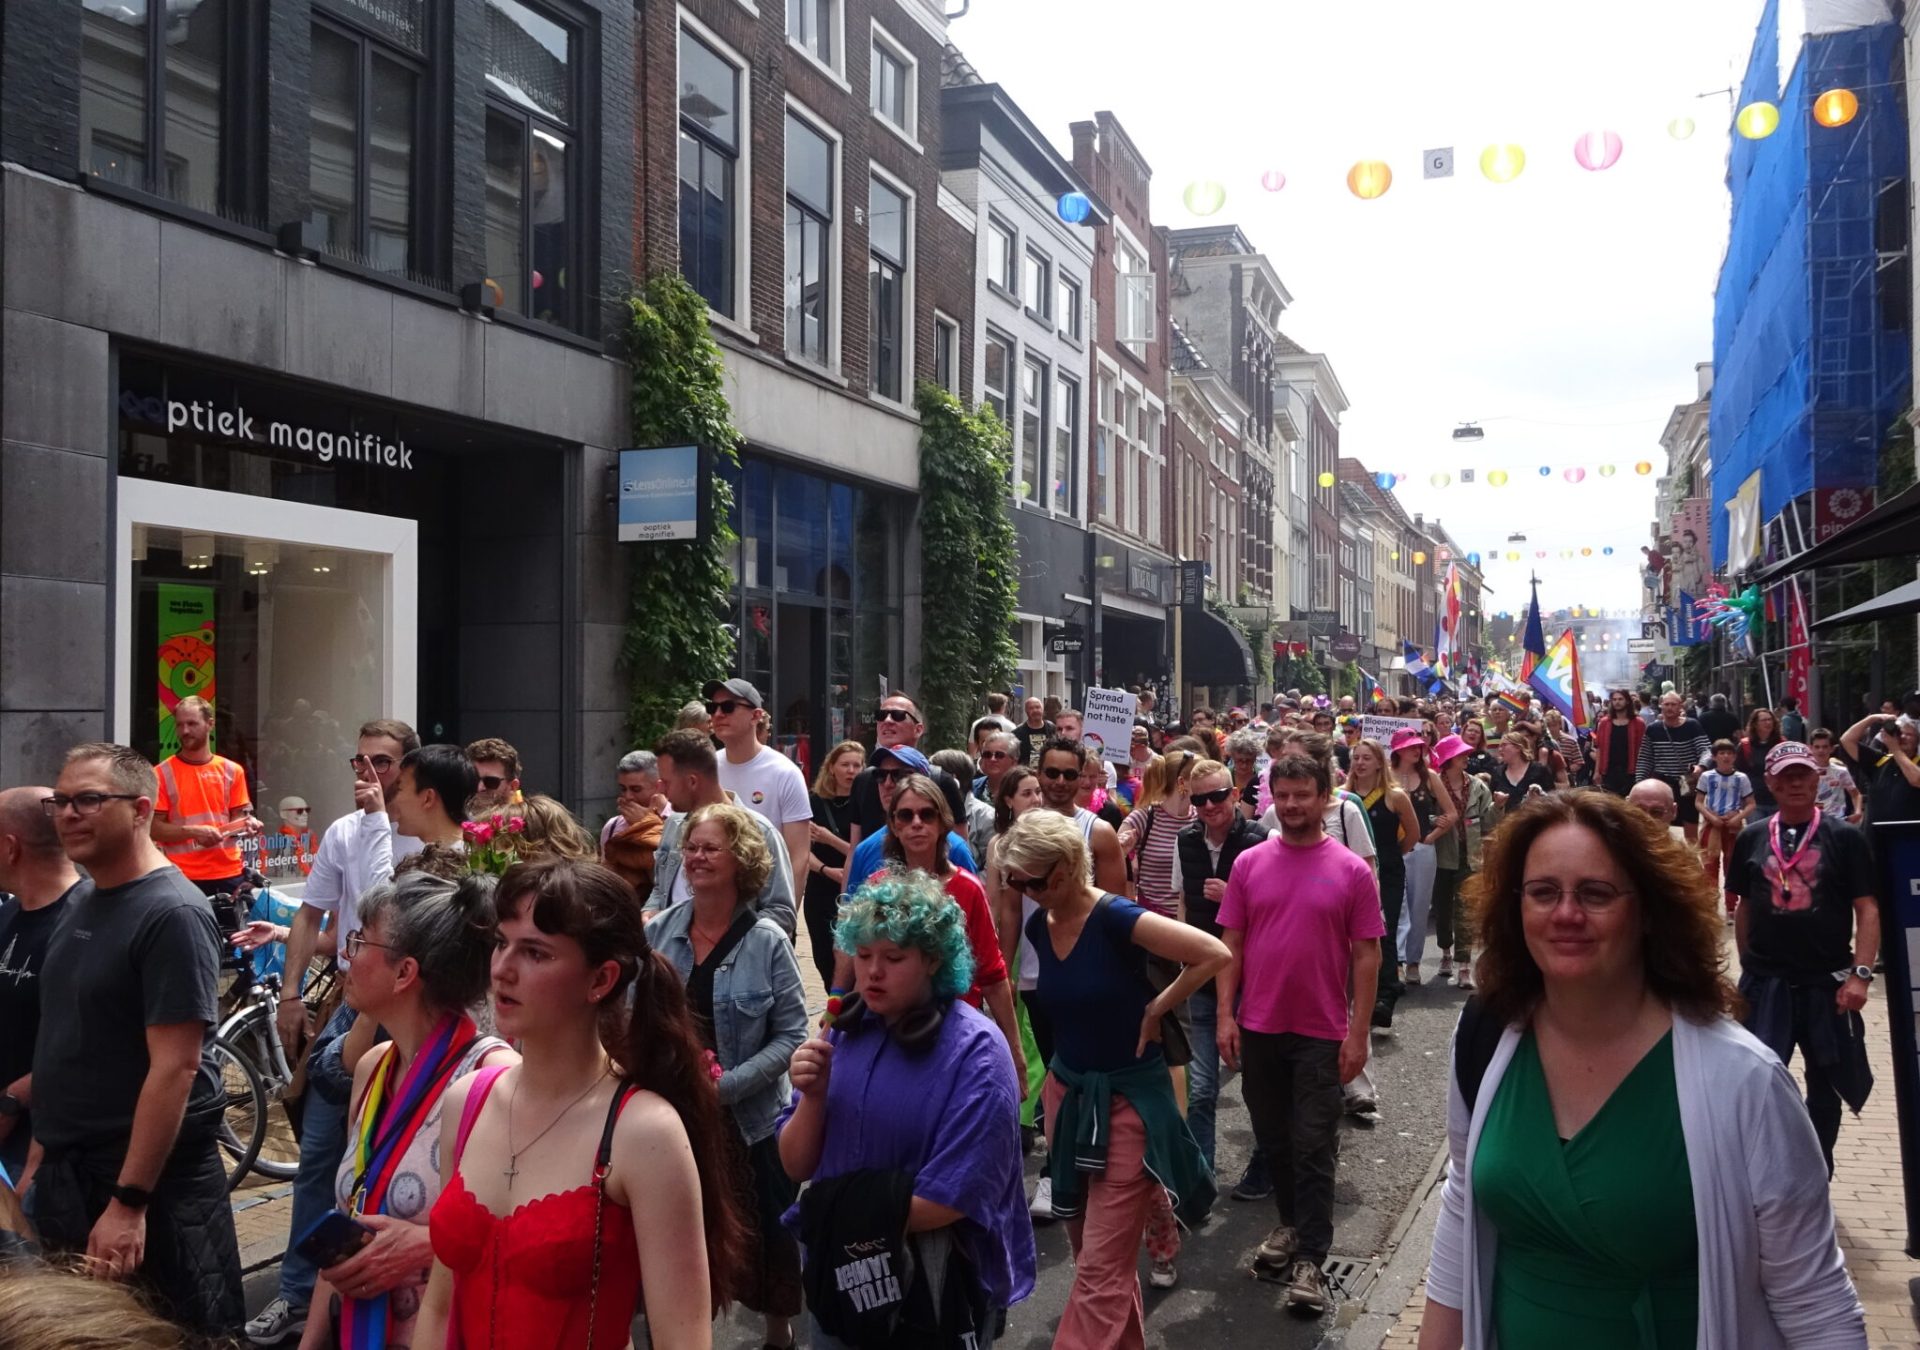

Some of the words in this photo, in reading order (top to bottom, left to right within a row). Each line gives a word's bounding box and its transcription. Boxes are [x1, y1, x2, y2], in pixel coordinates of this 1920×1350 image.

[1433, 156, 1444, 170] G
[270, 420, 414, 471] magnifiek
[1089, 690, 1124, 703] Spread
[1088, 701, 1132, 716] hummus,
[1087, 712, 1103, 721] not
[1105, 713, 1126, 724] hate
[1364, 717, 1409, 728] Bloemetjes
[265, 855, 298, 868] iedere
